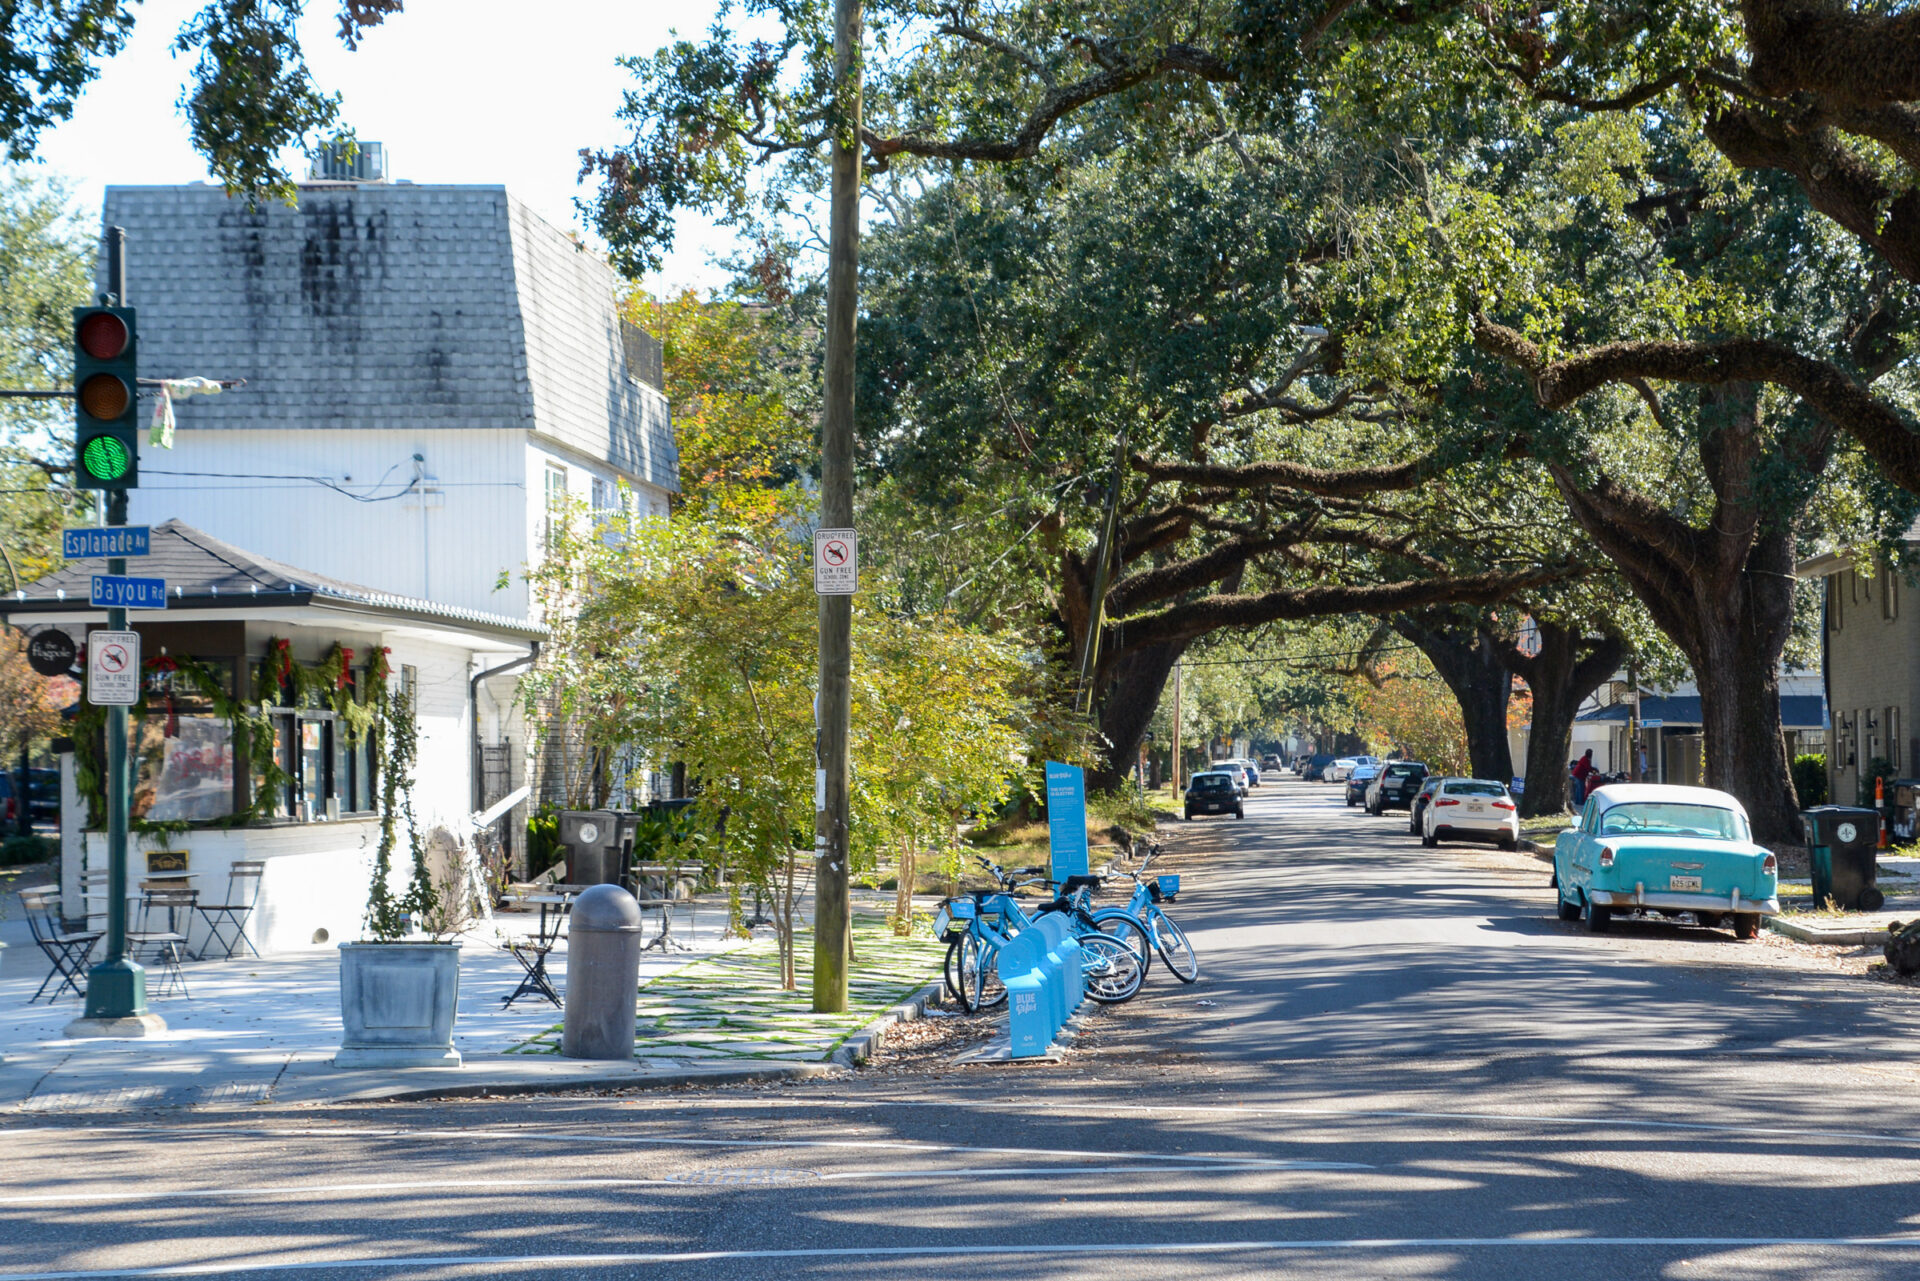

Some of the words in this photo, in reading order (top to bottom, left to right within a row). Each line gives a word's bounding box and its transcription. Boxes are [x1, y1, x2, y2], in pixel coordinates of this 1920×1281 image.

[837, 532, 854, 540] FREE
[65, 531, 133, 556] Esplanade
[94, 577, 147, 604] Bayou
[152, 586, 164, 600] Rd
[116, 636, 135, 644] FREE
[95, 674, 110, 682] GUN
[113, 674, 132, 682] FREE
[1015, 992, 1036, 1004] BLUE
